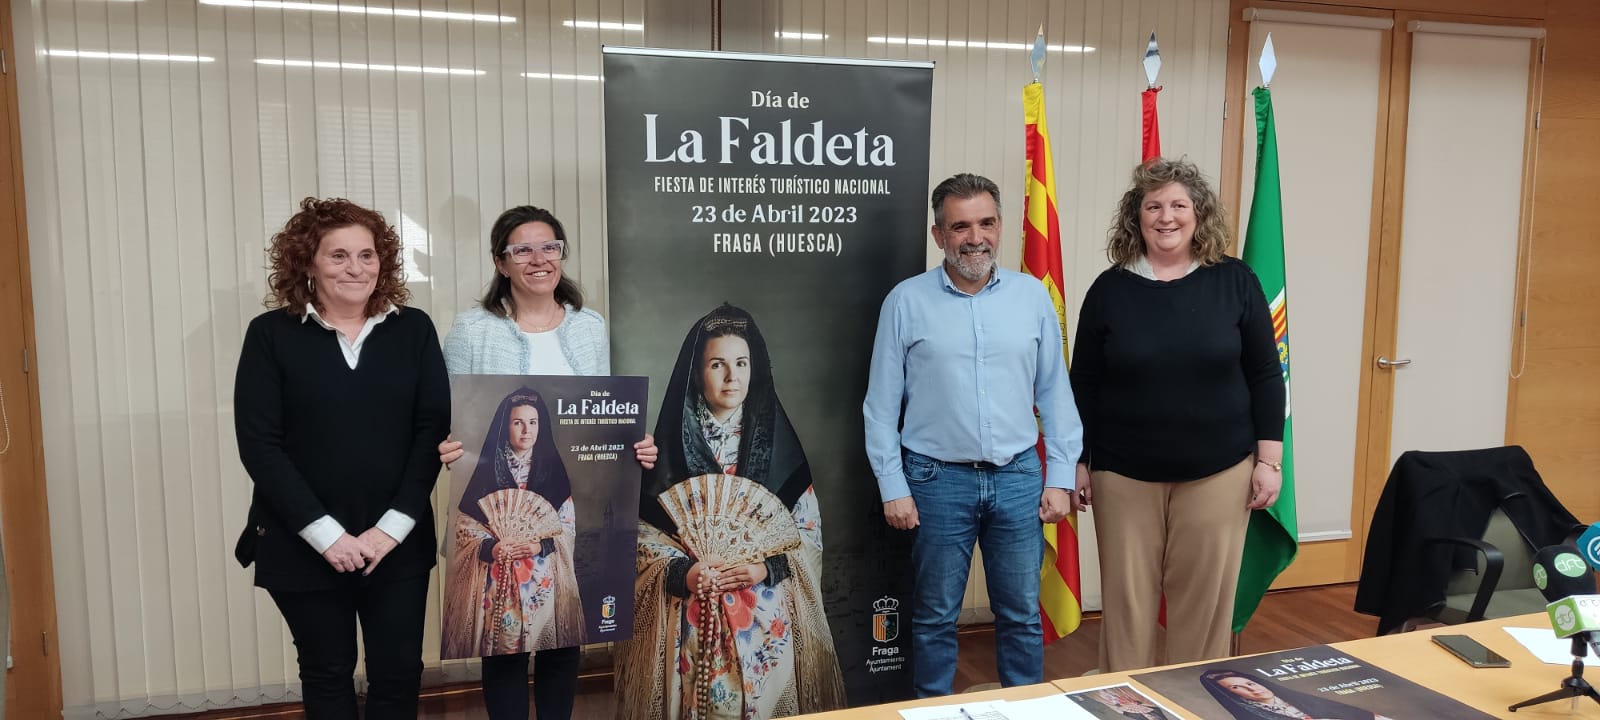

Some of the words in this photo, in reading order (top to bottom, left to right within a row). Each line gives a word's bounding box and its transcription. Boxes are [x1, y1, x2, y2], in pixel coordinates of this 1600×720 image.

[751, 90, 783, 109] Día
[787, 91, 810, 109] de
[643, 113, 707, 164] La
[718, 116, 897, 167] Faldeta
[654, 176, 695, 193] FIESTA
[699, 176, 715, 193] DE
[718, 173, 766, 194] INTERÉS
[769, 174, 830, 195] TURÍSTICO
[834, 178, 891, 195] NACIONAL
[691, 205, 717, 223] 23
[721, 203, 747, 223] de
[750, 203, 804, 224] Abril
[808, 206, 857, 224] 2023
[713, 232, 762, 253] FRAGA
[768, 233, 842, 257] (HUESCA)
[557, 399, 577, 415] La
[581, 399, 639, 415] Faldeta
[577, 453, 593, 461] FRAGA
[580, 444, 589, 452] de
[872, 646, 899, 656] Fraga
[865, 656, 905, 667] Ayuntamiento
[1255, 668, 1288, 677] La
[1280, 656, 1354, 673] Faldeta
